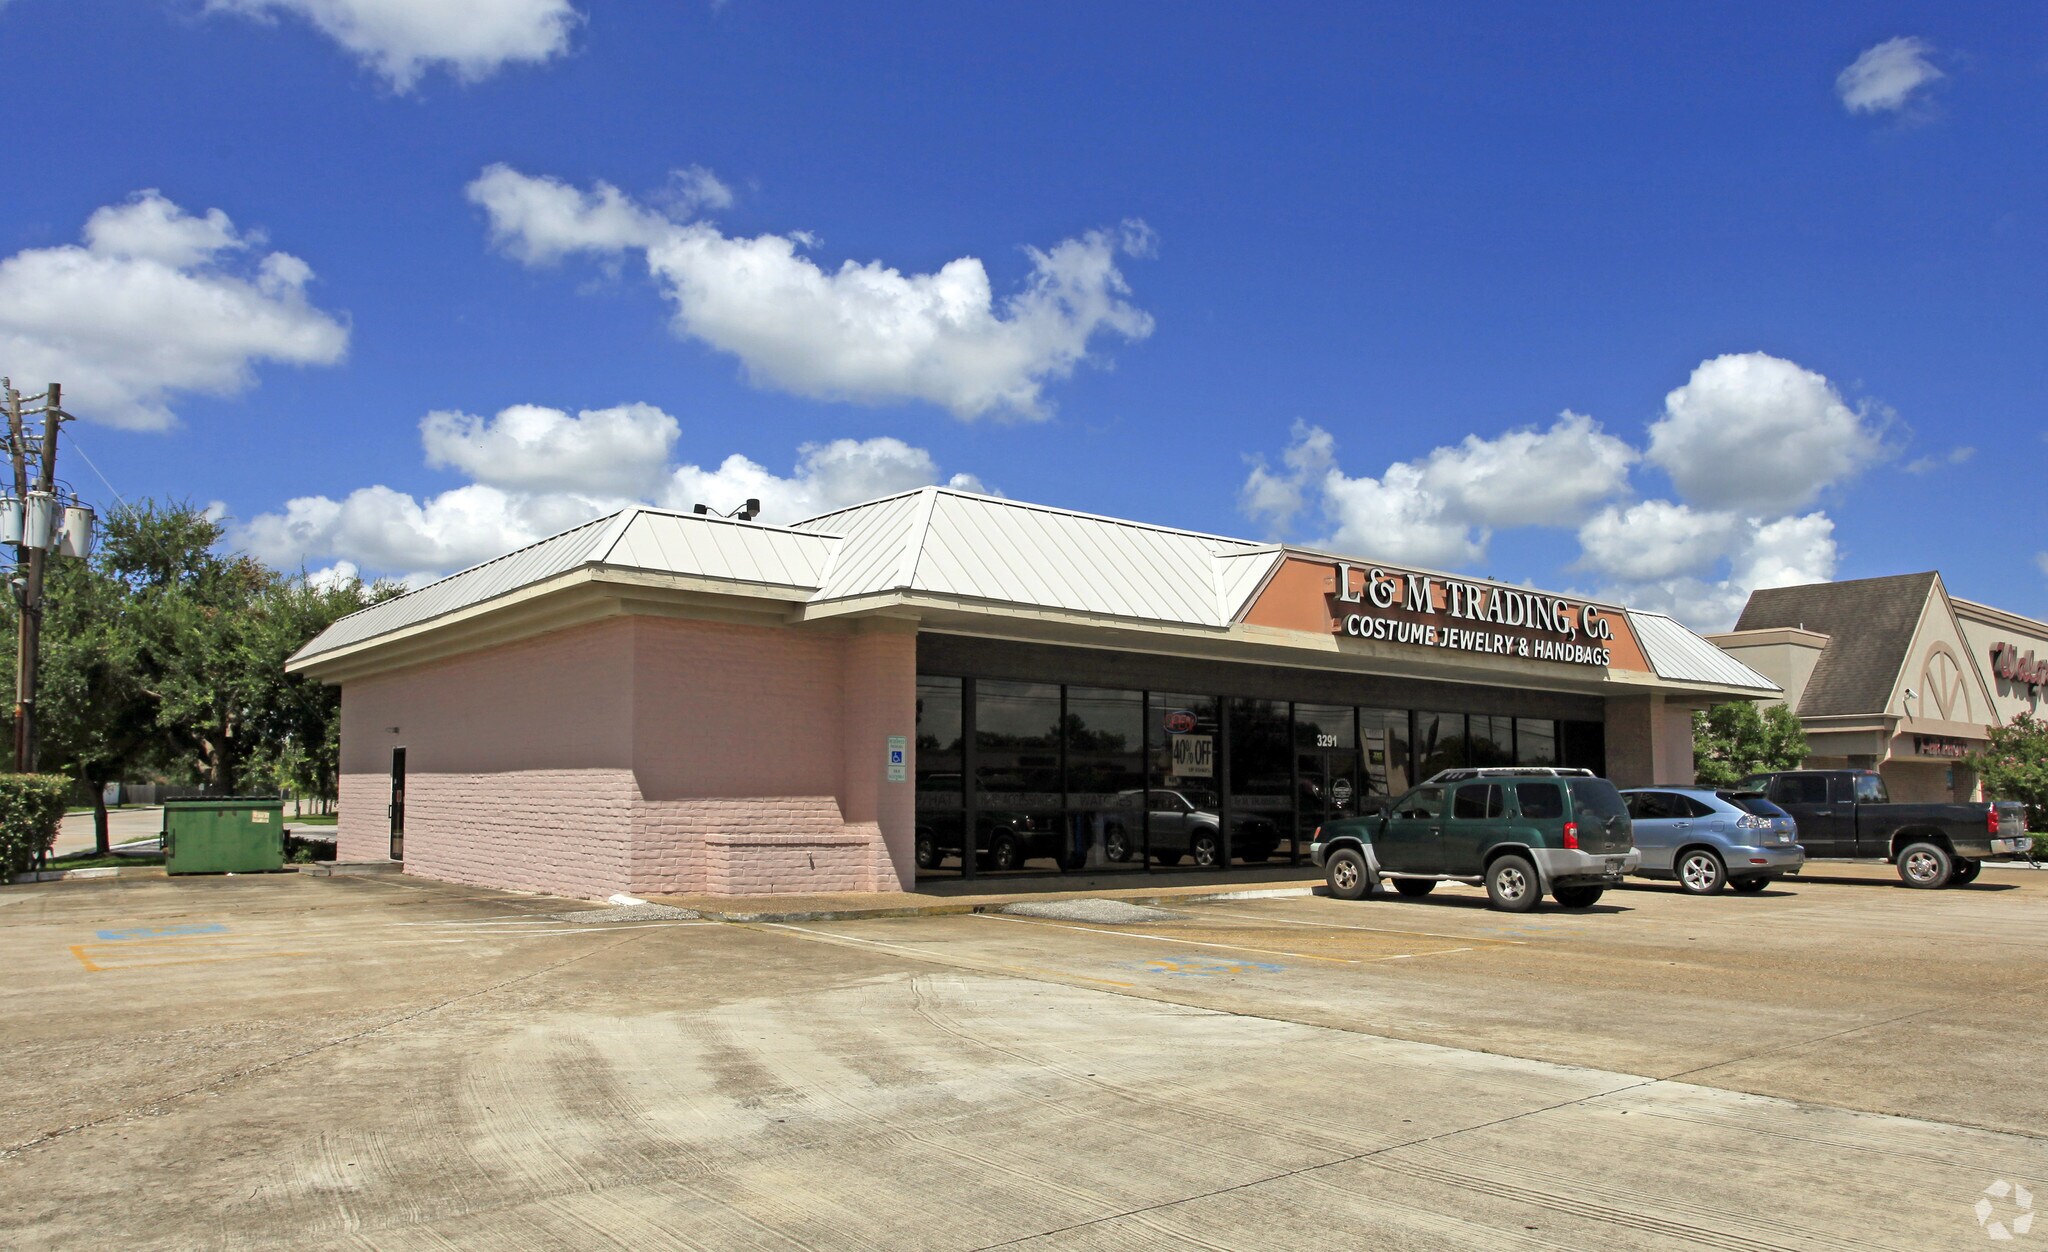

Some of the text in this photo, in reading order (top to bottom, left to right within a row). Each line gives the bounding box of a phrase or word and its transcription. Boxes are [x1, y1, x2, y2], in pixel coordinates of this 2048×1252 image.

[1336, 562, 1616, 641] L & M TRADING, Co.
[1345, 613, 1611, 666] COSTUME JEWELRY & HANDBAGS
[1164, 713, 1194, 732] OPEN
[1173, 739, 1212, 766] 40% OFF
[1316, 734, 1338, 748] 3291
